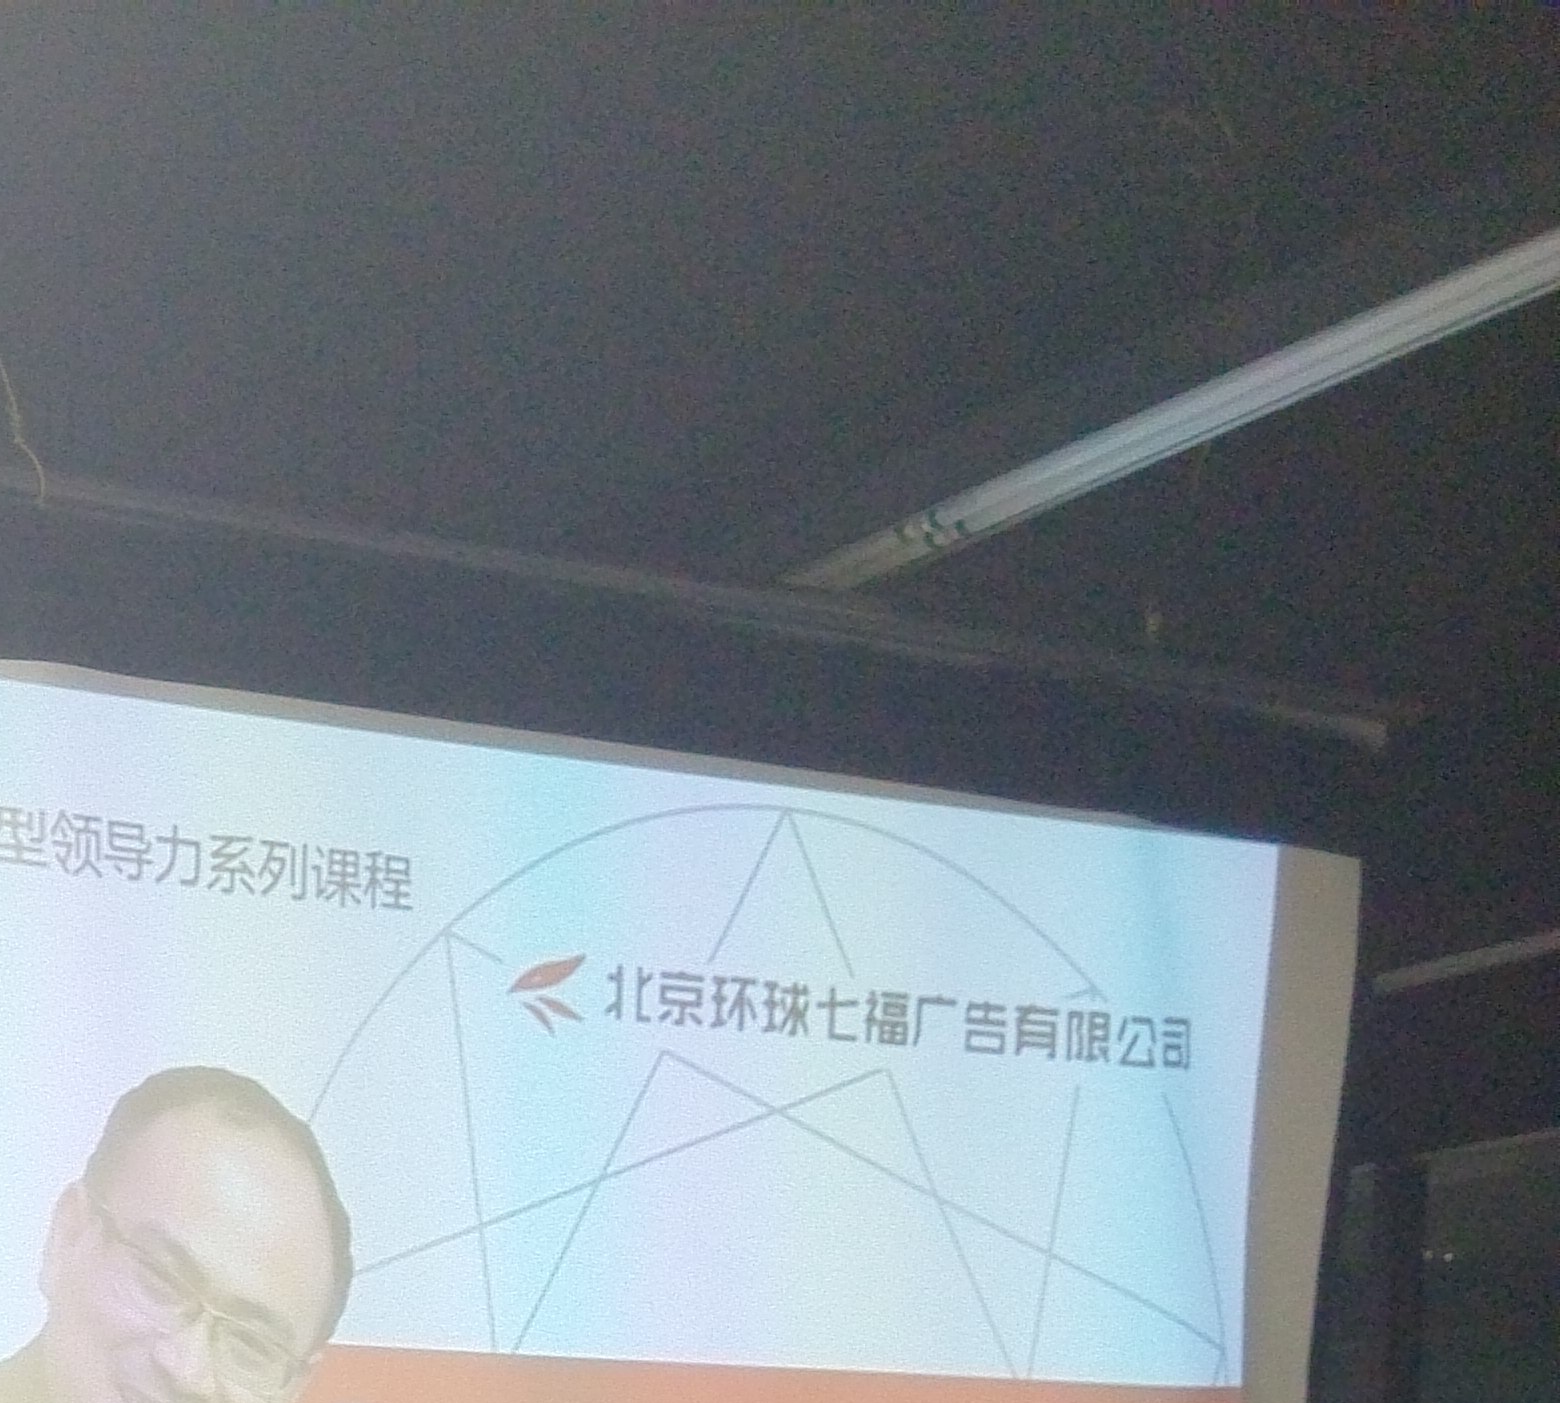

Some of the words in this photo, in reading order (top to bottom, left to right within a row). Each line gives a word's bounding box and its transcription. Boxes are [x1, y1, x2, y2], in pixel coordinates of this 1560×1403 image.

[604, 964, 1193, 1071] 北京环球七福广告有限公司
